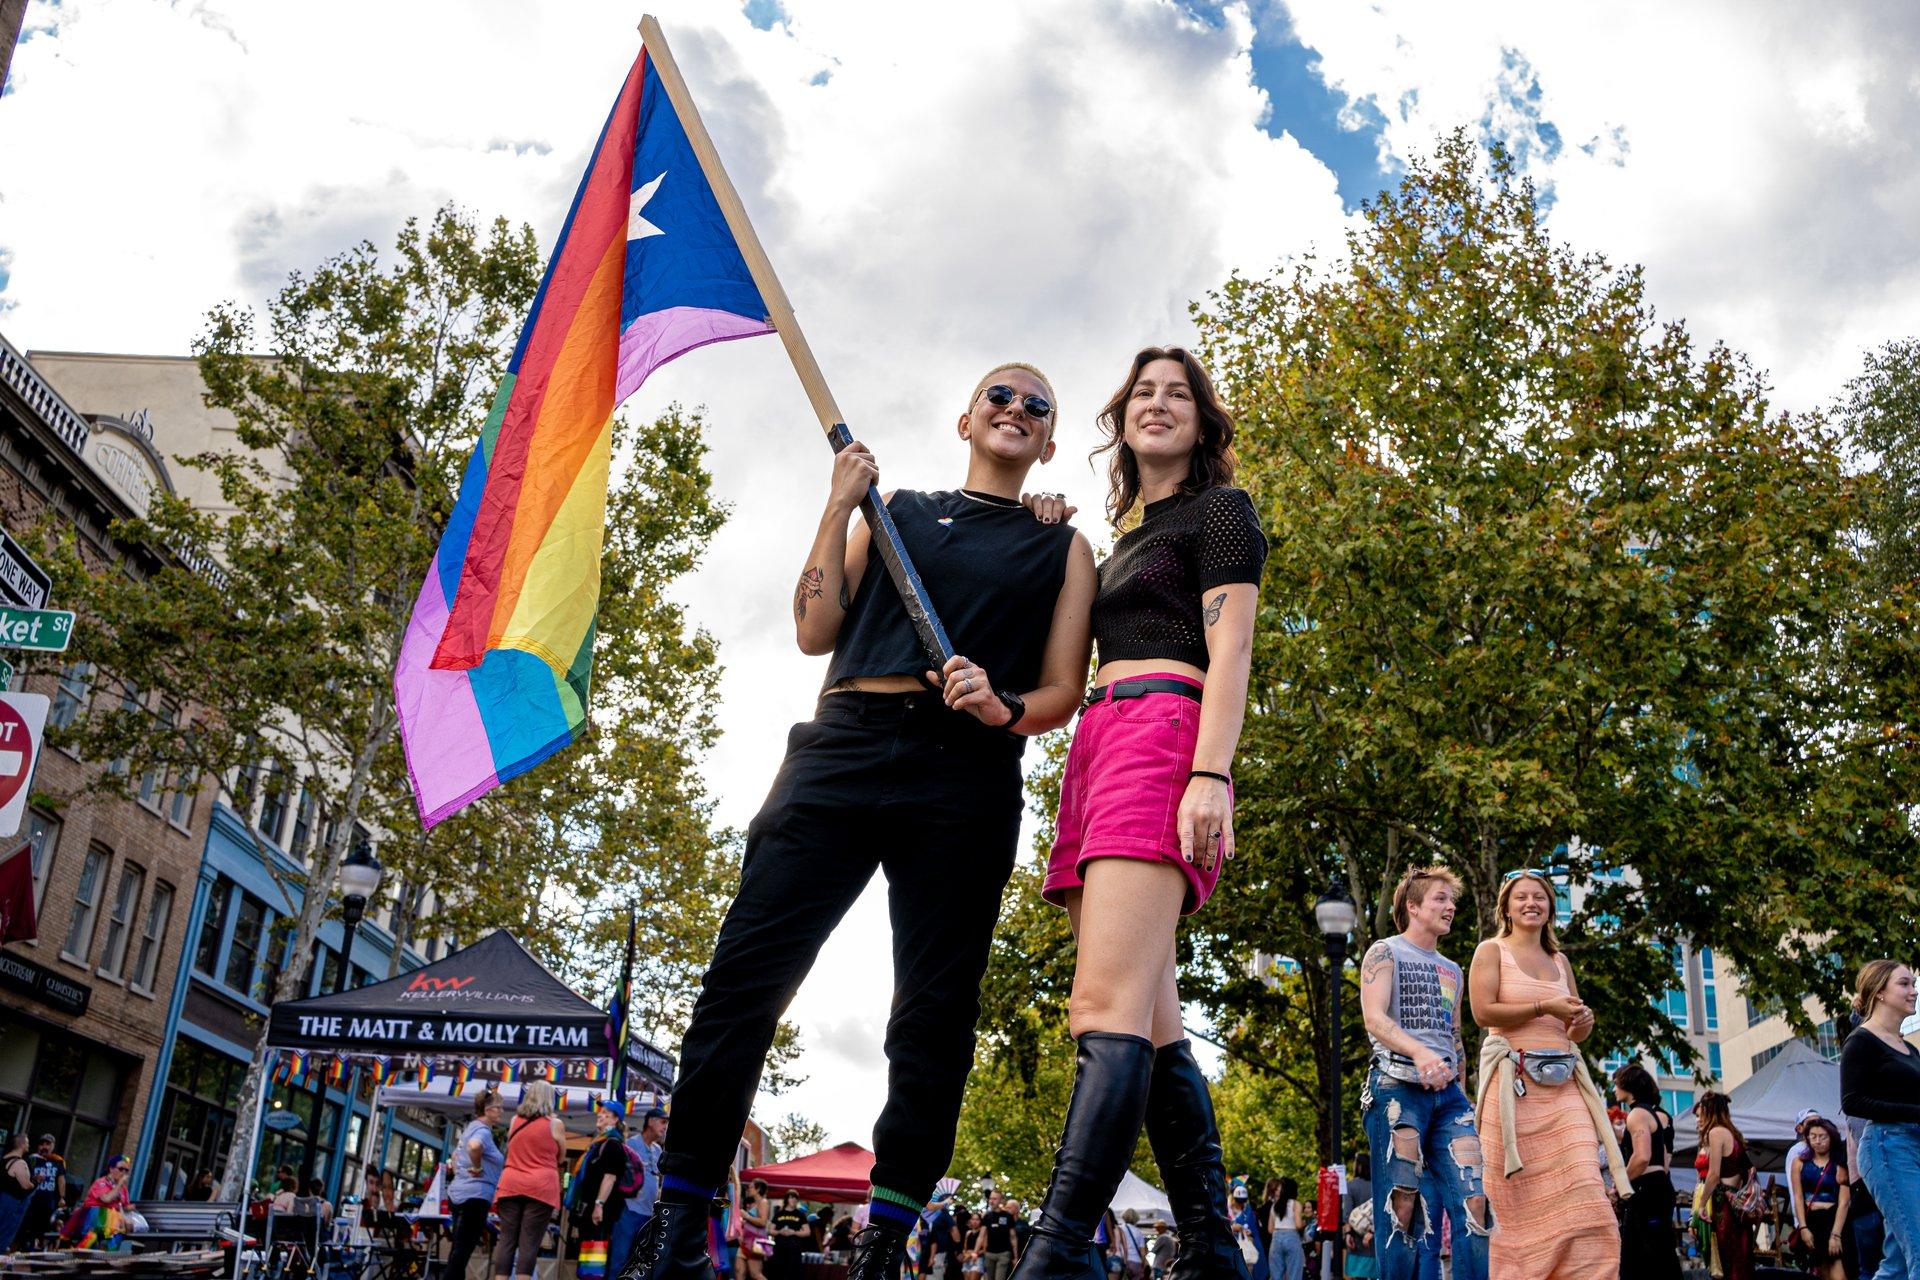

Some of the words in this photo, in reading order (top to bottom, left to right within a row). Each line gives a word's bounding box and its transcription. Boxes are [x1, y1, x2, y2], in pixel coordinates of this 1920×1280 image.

[18, 572, 40, 604] WAY
[53, 616, 69, 631] St
[299, 1016, 342, 1037] THE
[348, 1018, 412, 1039] MATT
[418, 1022, 434, 1040] &
[441, 1022, 520, 1044] MOLLY
[526, 1025, 588, 1047] TEAM
